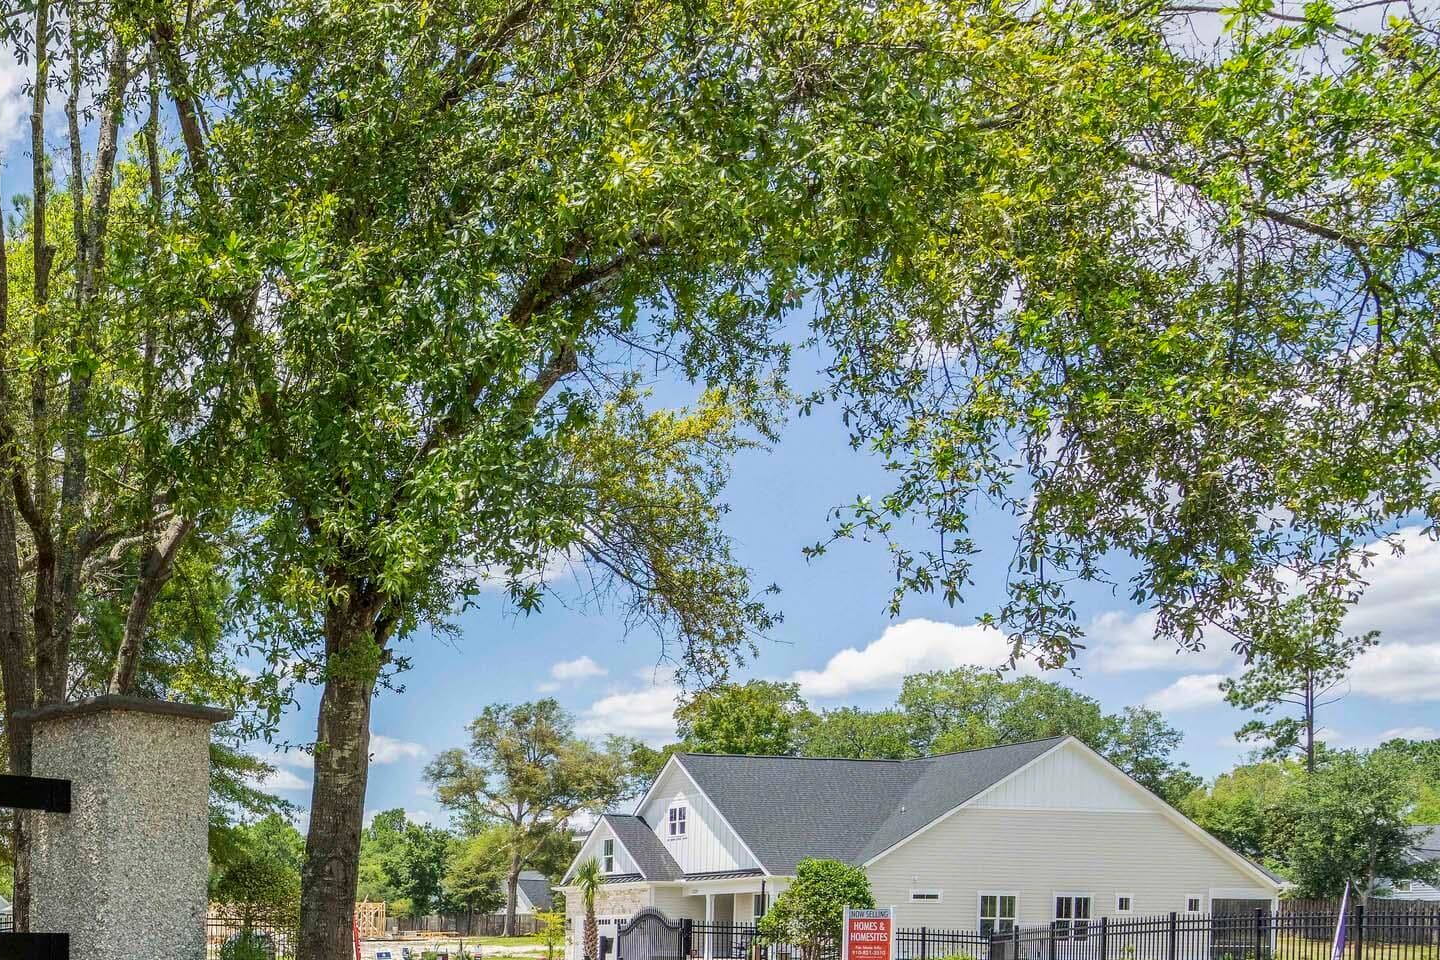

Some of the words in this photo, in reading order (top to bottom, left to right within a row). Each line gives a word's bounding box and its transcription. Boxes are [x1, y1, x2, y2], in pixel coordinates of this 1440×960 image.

[853, 922, 877, 931] HOMES
[879, 922, 885, 931] &
[850, 932, 888, 941] HOMESITES
